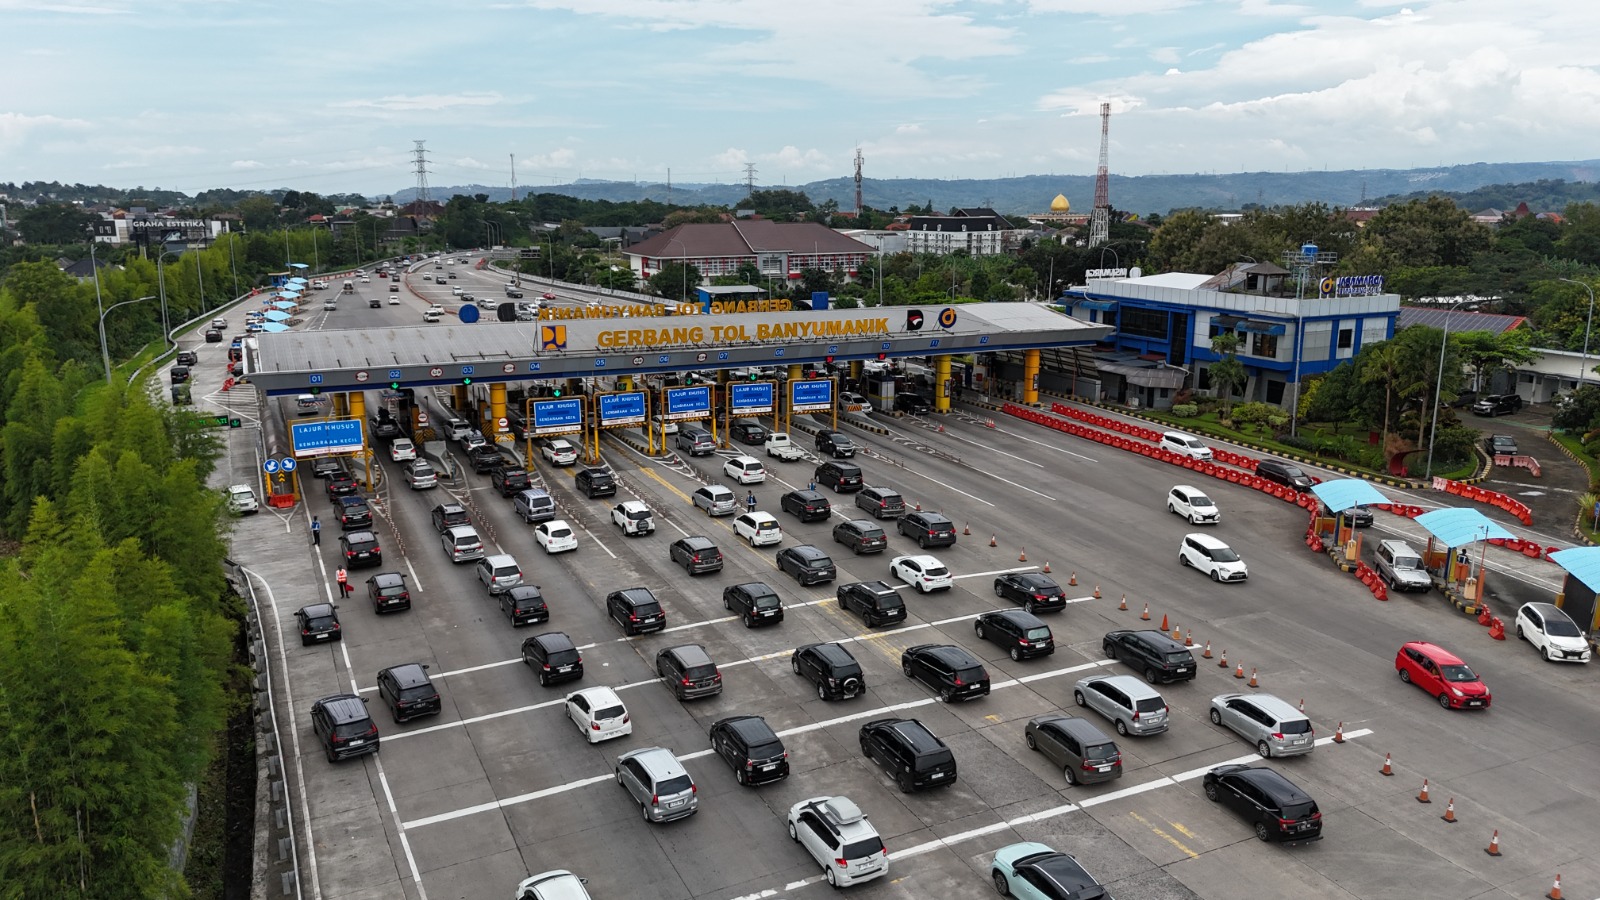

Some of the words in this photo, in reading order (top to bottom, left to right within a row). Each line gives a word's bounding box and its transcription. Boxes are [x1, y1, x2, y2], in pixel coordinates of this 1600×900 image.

[166, 220, 206, 228] ESTETIKA
[597, 326, 704, 348] GERBANG
[709, 325, 751, 342] TOL
[756, 317, 890, 340] BANYUMANIK
[299, 425, 322, 433] LAJUR
[325, 423, 355, 431] KHUSUS
